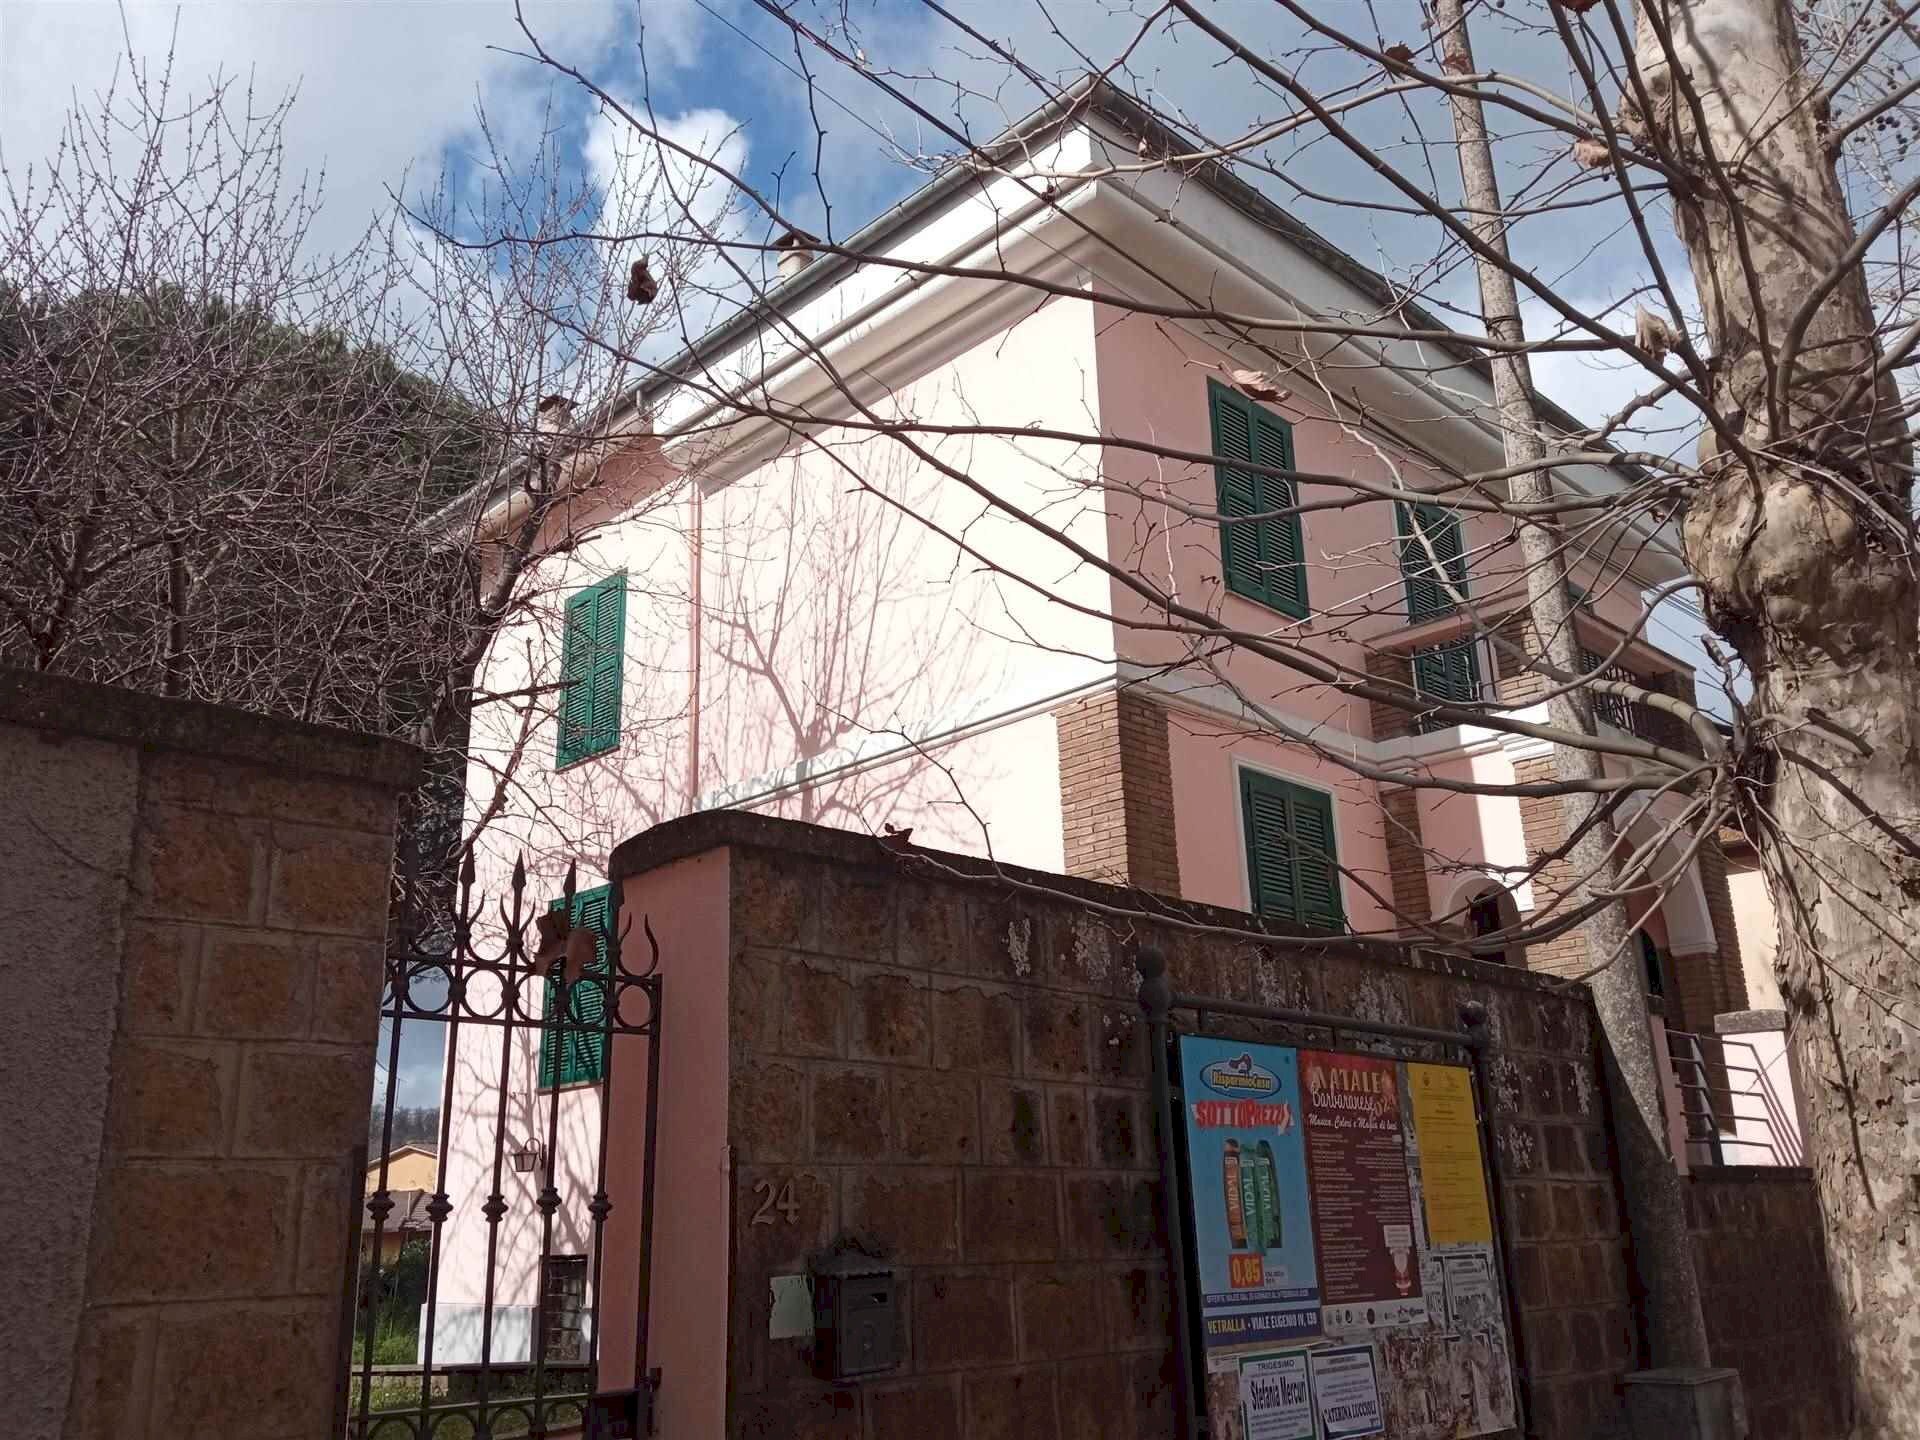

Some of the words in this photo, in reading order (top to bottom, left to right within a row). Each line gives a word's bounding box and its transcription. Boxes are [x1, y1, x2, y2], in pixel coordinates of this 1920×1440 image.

[1311, 1066, 1382, 1093] NATALE
[751, 1180, 801, 1225] 24
[1226, 1175, 1241, 1211] VIDAL
[1242, 1176, 1257, 1216] VIDAL
[1261, 1174, 1273, 1209] VIDAL
[1208, 1318, 1246, 1334] VETRALLA
[1252, 1314, 1270, 1330] VIALE
[1272, 1313, 1296, 1328] EUGENIO
[1258, 1359, 1295, 1370] TRIGESIMO
[1251, 1377, 1280, 1410] Stefania
[1280, 1373, 1307, 1406] Mercuri
